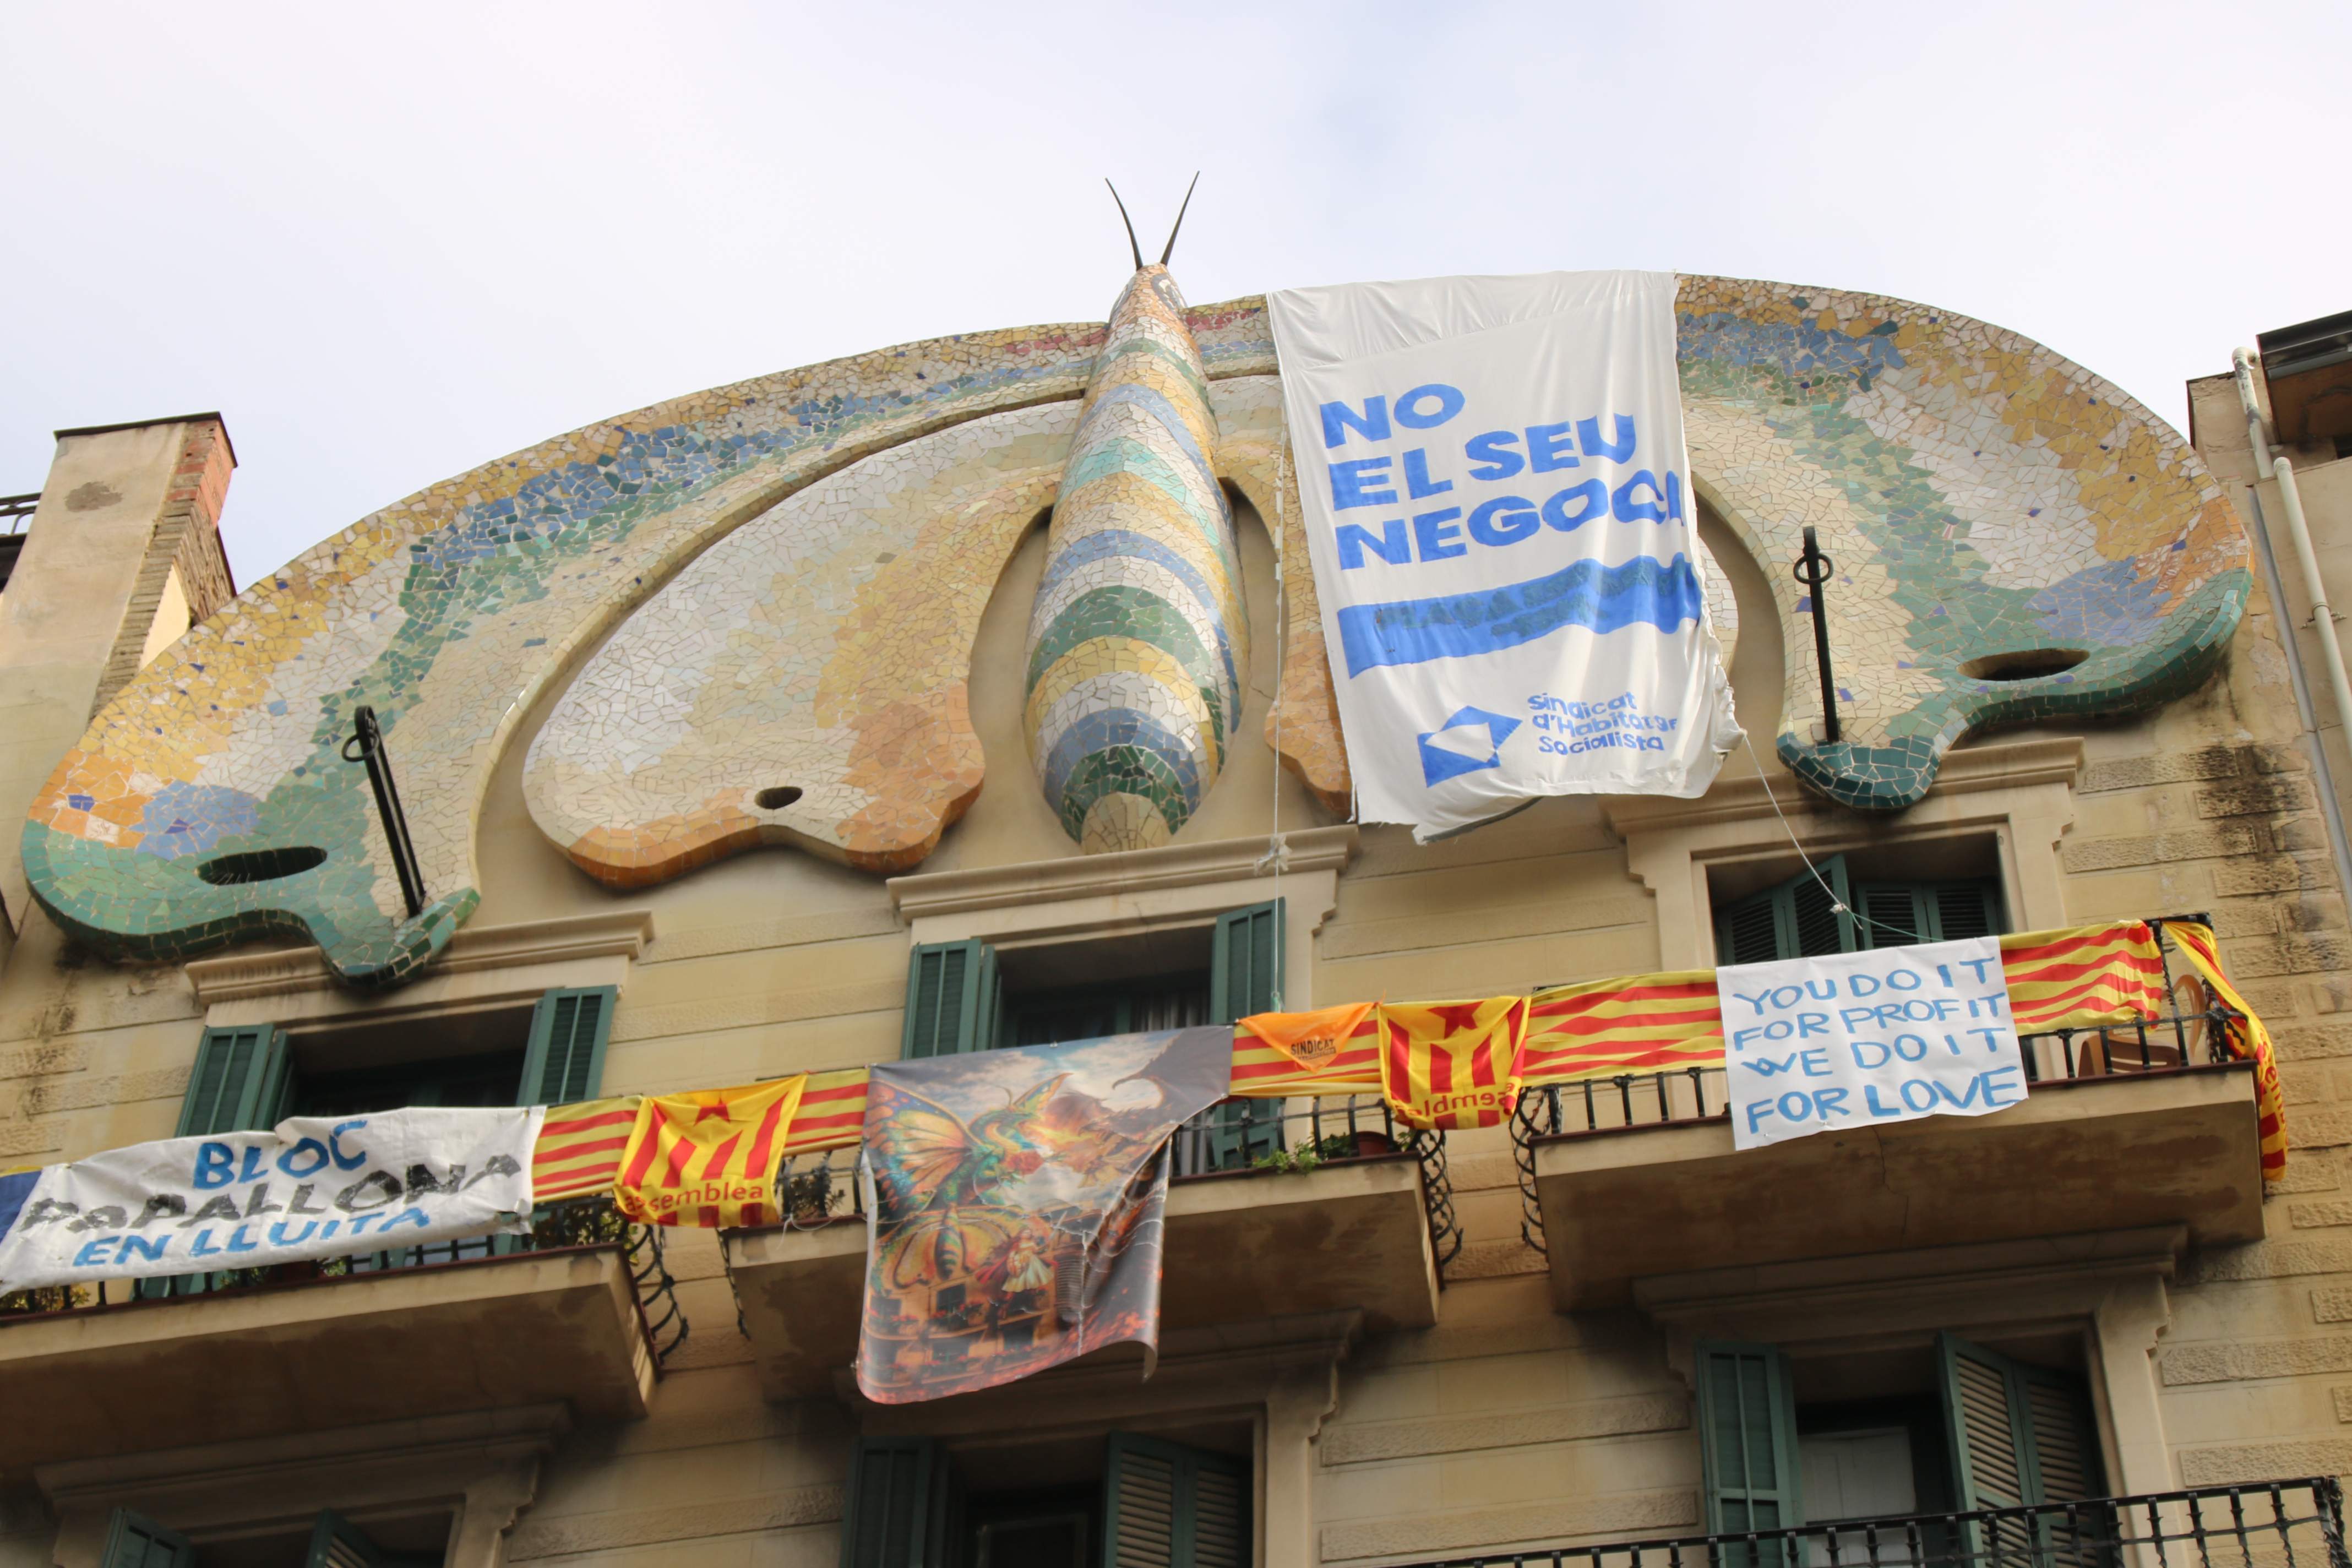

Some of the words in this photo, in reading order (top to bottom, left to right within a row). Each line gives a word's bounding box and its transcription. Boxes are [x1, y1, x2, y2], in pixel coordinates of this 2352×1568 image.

[1319, 383, 1466, 449] NO
[1329, 448, 1453, 510] EL
[1465, 413, 1636, 481] SEU
[1335, 469, 1685, 570] NEGOCI
[1733, 979, 1837, 1016] YOU
[1848, 968, 1921, 998] DO
[1936, 956, 1995, 988] IT
[1291, 1038, 1335, 1055] SINDICAT
[1733, 1012, 1830, 1051] FOR
[1839, 993, 2006, 1033] PROFIT
[1741, 1047, 1833, 1076] WE
[1850, 1033, 1926, 1069] DO
[1944, 1027, 2006, 1055] IT
[1746, 1086, 1851, 1134] FOR
[1864, 1065, 2023, 1117] LOVE
[192, 1120, 368, 1190] BLOC
[624, 1182, 763, 1212] assemblea
[72, 1233, 171, 1266] EN
[189, 1206, 431, 1257] LLUITA
